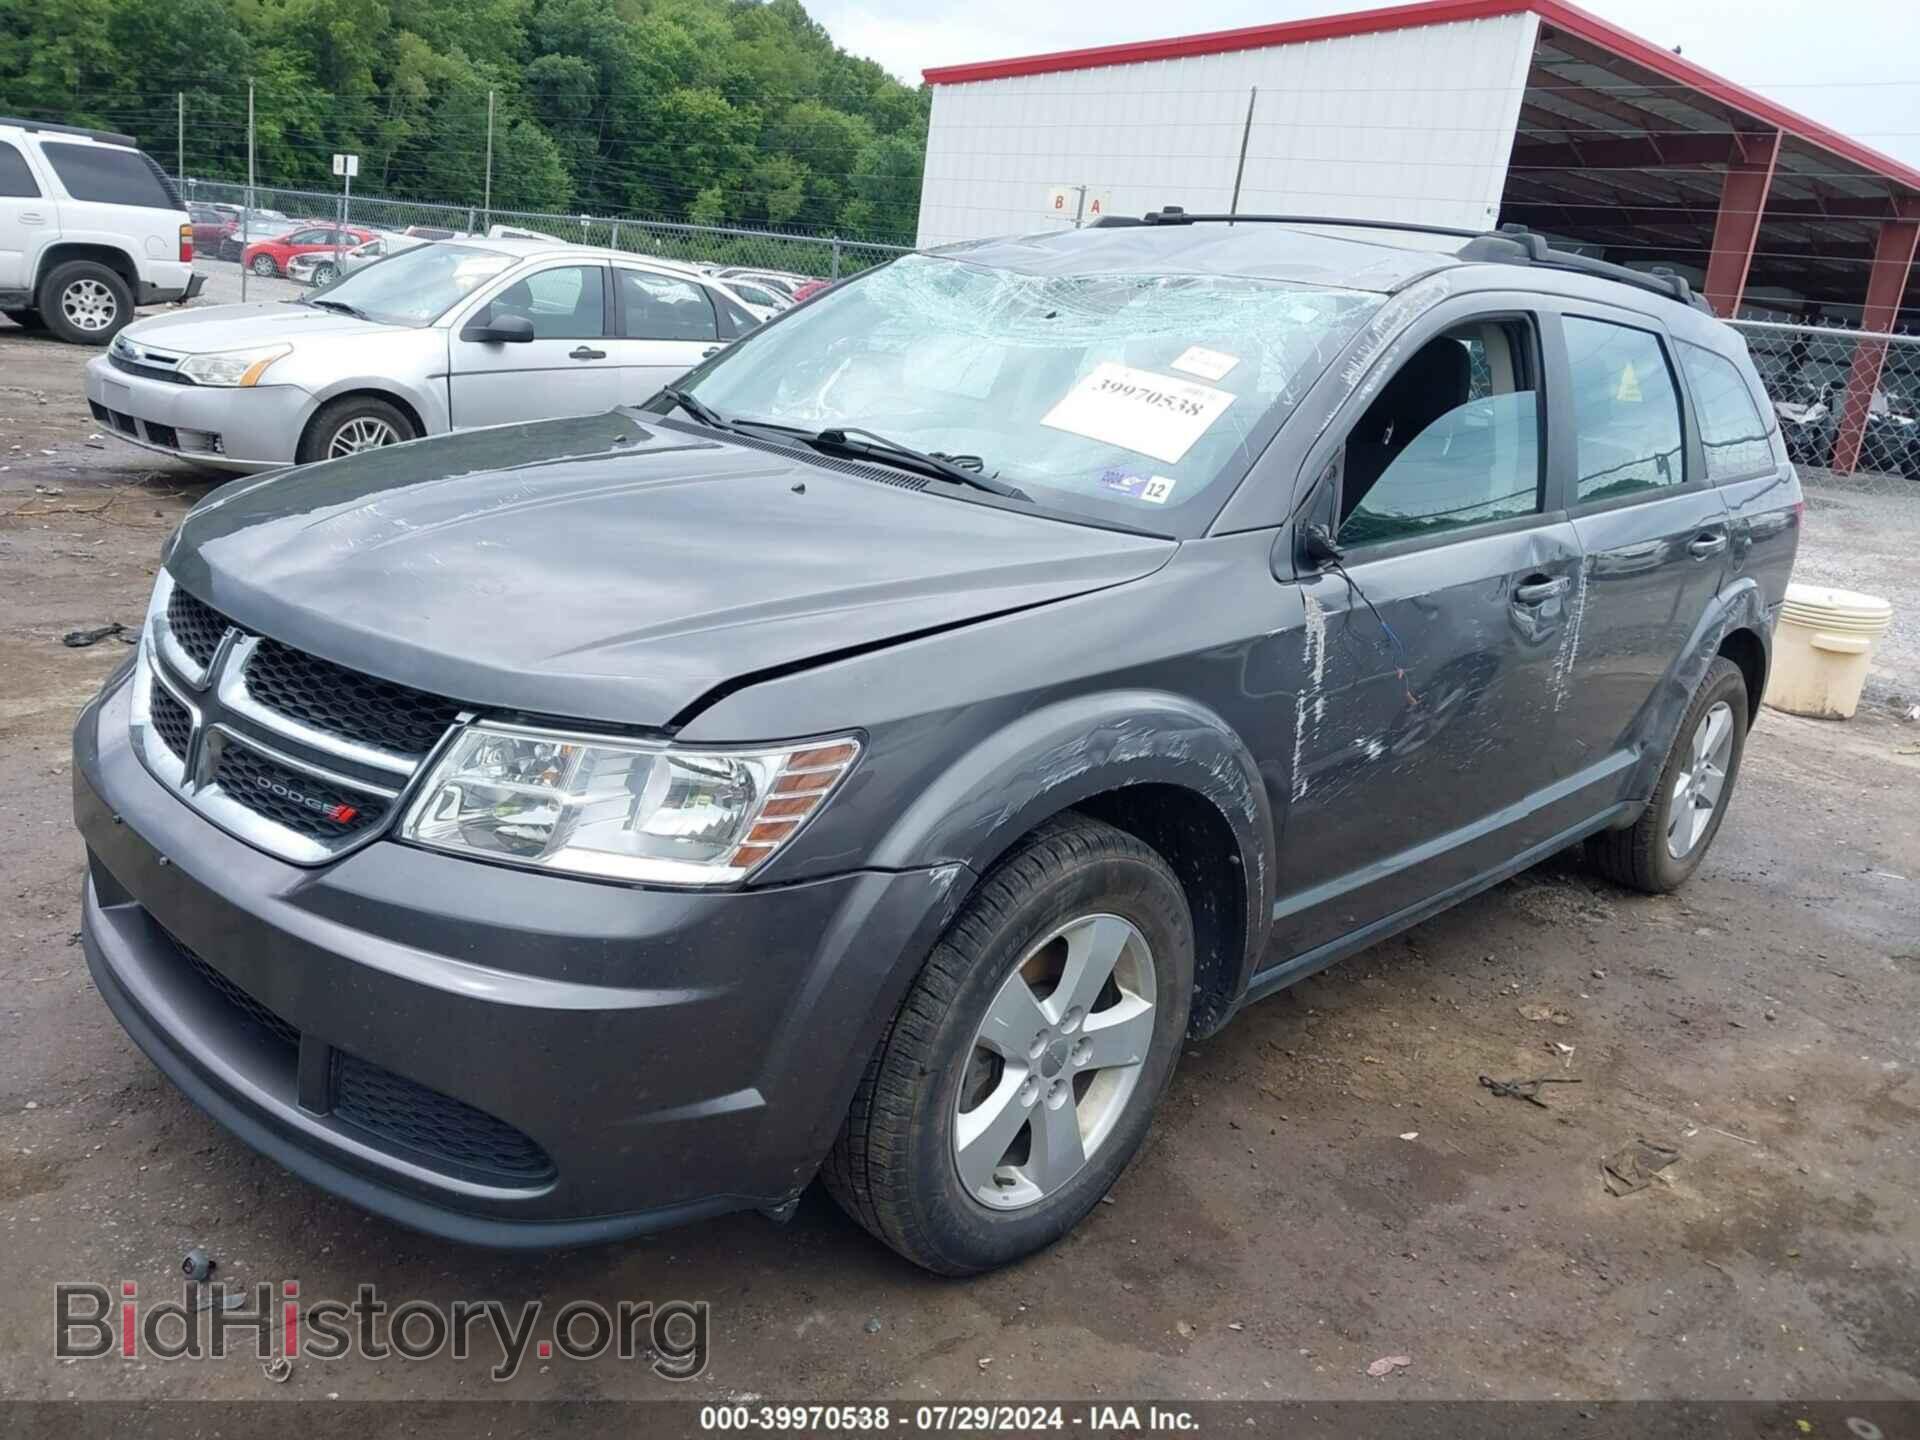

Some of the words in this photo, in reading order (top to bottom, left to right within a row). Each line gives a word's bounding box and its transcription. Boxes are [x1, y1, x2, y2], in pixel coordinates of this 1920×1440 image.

[1055, 195, 1064, 209] B
[1091, 199, 1100, 214] A
[1092, 378, 1204, 417] 39970538
[1145, 482, 1166, 498] 12
[257, 776, 341, 818] DODGE
